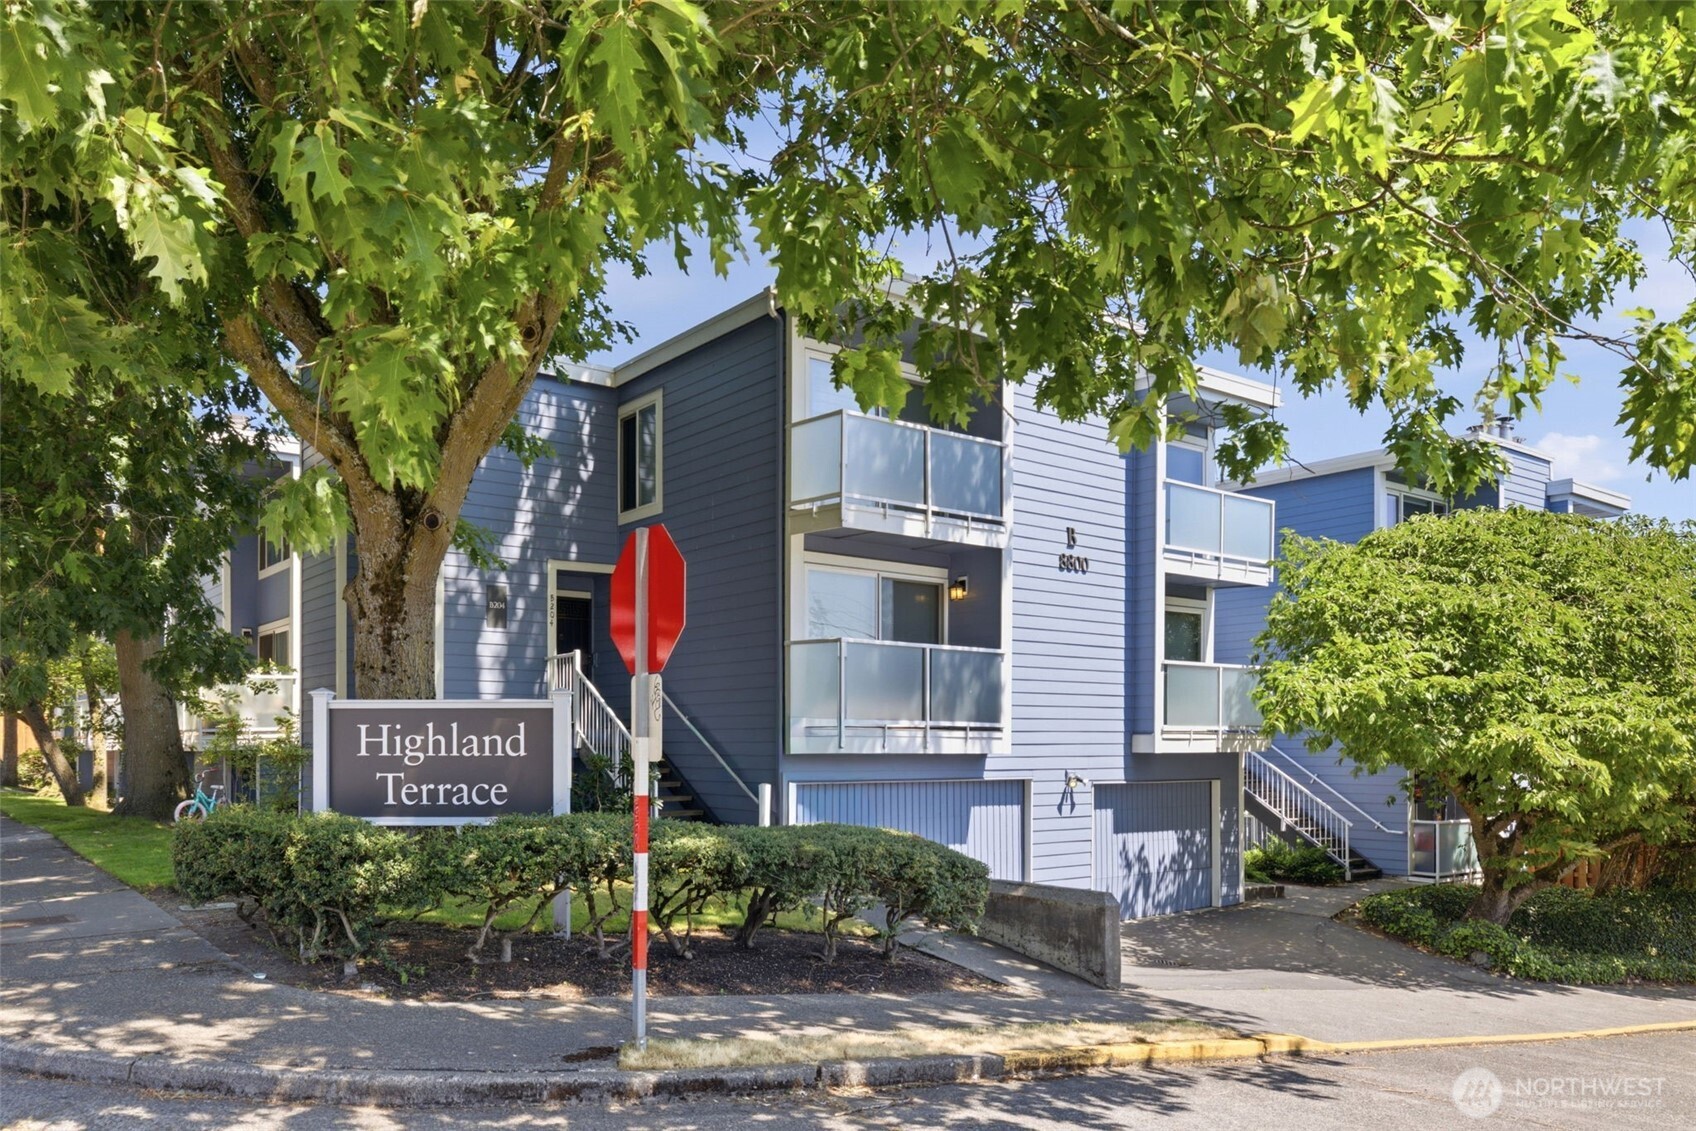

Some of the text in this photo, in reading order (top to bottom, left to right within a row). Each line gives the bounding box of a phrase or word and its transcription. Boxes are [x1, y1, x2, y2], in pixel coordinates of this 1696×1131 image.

[1066, 527, 1077, 549] B
[1058, 553, 1089, 575] 8800
[356, 721, 528, 766] Highland
[376, 772, 508, 806] Terrace
